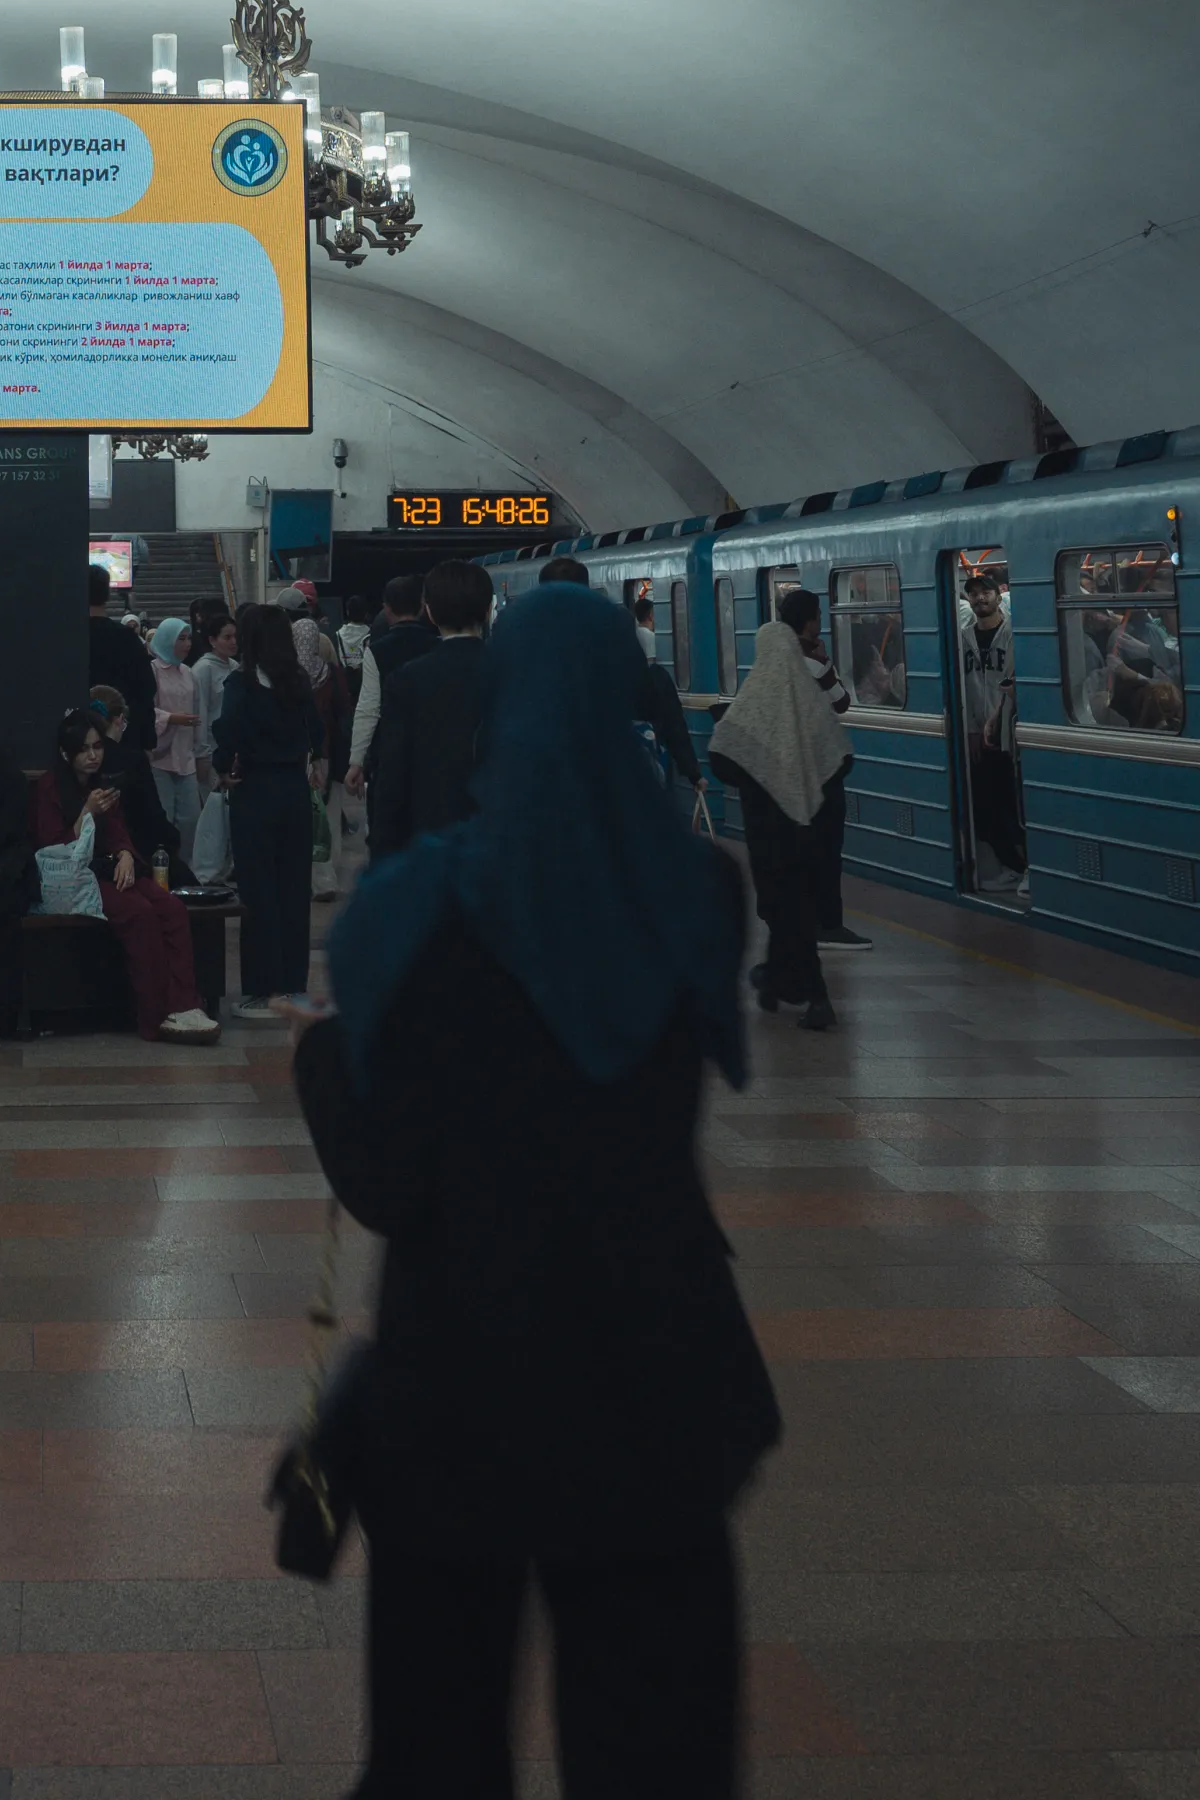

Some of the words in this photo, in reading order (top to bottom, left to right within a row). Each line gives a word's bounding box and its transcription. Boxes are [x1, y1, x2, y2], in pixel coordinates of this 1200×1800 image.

[4, 164, 120, 187] вақтлари?
[13, 261, 56, 272] таҳлили
[58, 260, 65, 270] 1
[67, 259, 104, 272] йилда
[105, 259, 112, 270] 1
[114, 261, 153, 273] марта;
[66, 277, 122, 288] скрининги
[125, 275, 130, 285] 1
[133, 275, 170, 288] йилда
[172, 275, 178, 285] 1
[180, 276, 219, 288] марта;
[19, 289, 70, 303] бўлмаган
[72, 292, 138, 303] касалликлар
[143, 292, 213, 303] ривожланиш
[215, 290, 241, 303] хавф
[36, 323, 93, 334] скрининги
[95, 320, 103, 331] 3
[104, 320, 141, 334] йилда
[143, 321, 149, 331] 1
[151, 322, 190, 334] марта;
[22, 338, 79, 349] скрининги
[80, 336, 88, 347] 2
[89, 335, 127, 349] йилда
[128, 337, 135, 347] 1
[137, 338, 176, 350] марта;
[14, 352, 48, 365] кўрик,
[50, 353, 139, 364] ҳомиладорликка
[141, 354, 187, 362] монелик
[189, 354, 237, 364] аниқлаш
[2, 384, 41, 396] марта.
[26, 447, 76, 460] GROUP
[11, 470, 30, 481] 157
[32, 470, 46, 481] 32
[393, 497, 441, 525] 7:23
[462, 497, 549, 525] 15:48:26
